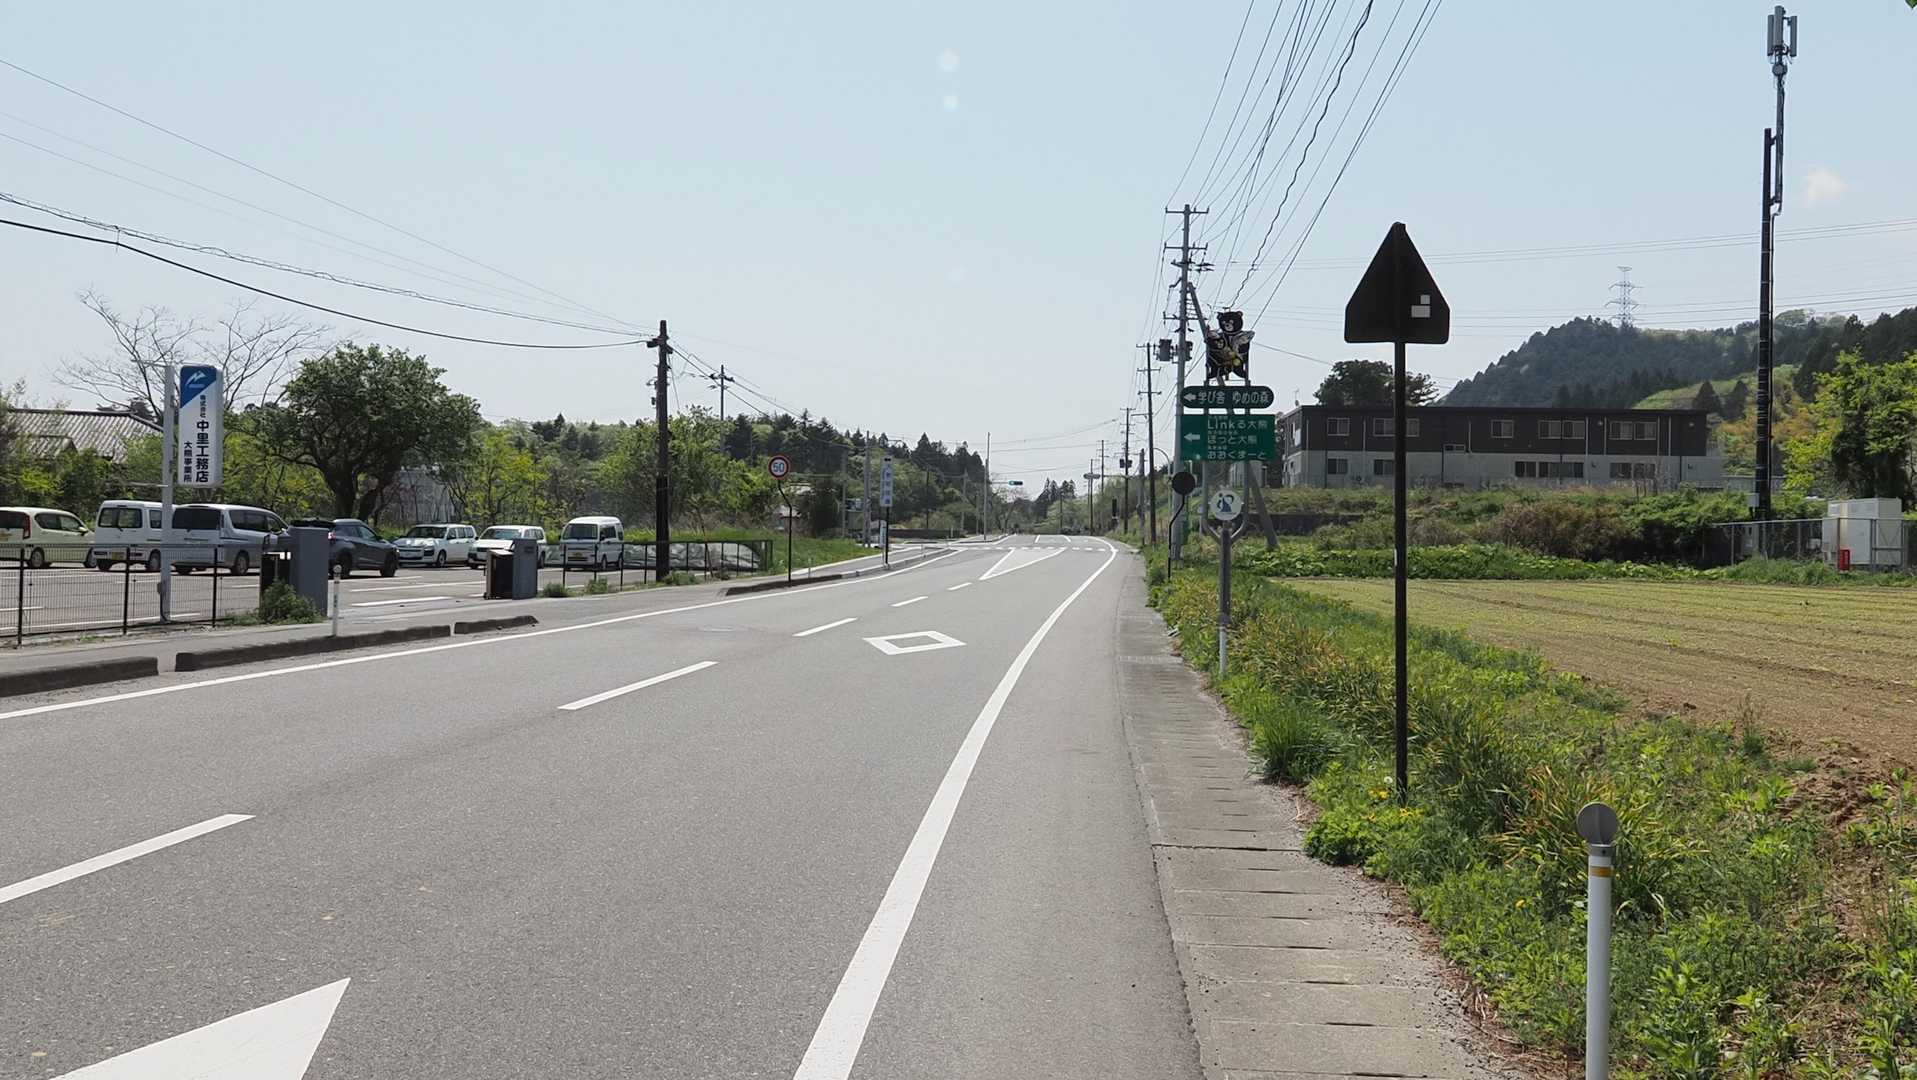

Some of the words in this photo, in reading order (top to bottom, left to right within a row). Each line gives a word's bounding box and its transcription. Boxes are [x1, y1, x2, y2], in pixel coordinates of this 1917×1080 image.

[1198, 391, 1225, 404] 学び舎
[1232, 391, 1269, 404] ゆめの森
[196, 420, 209, 483] 中里工務店
[774, 462, 785, 472] 50
